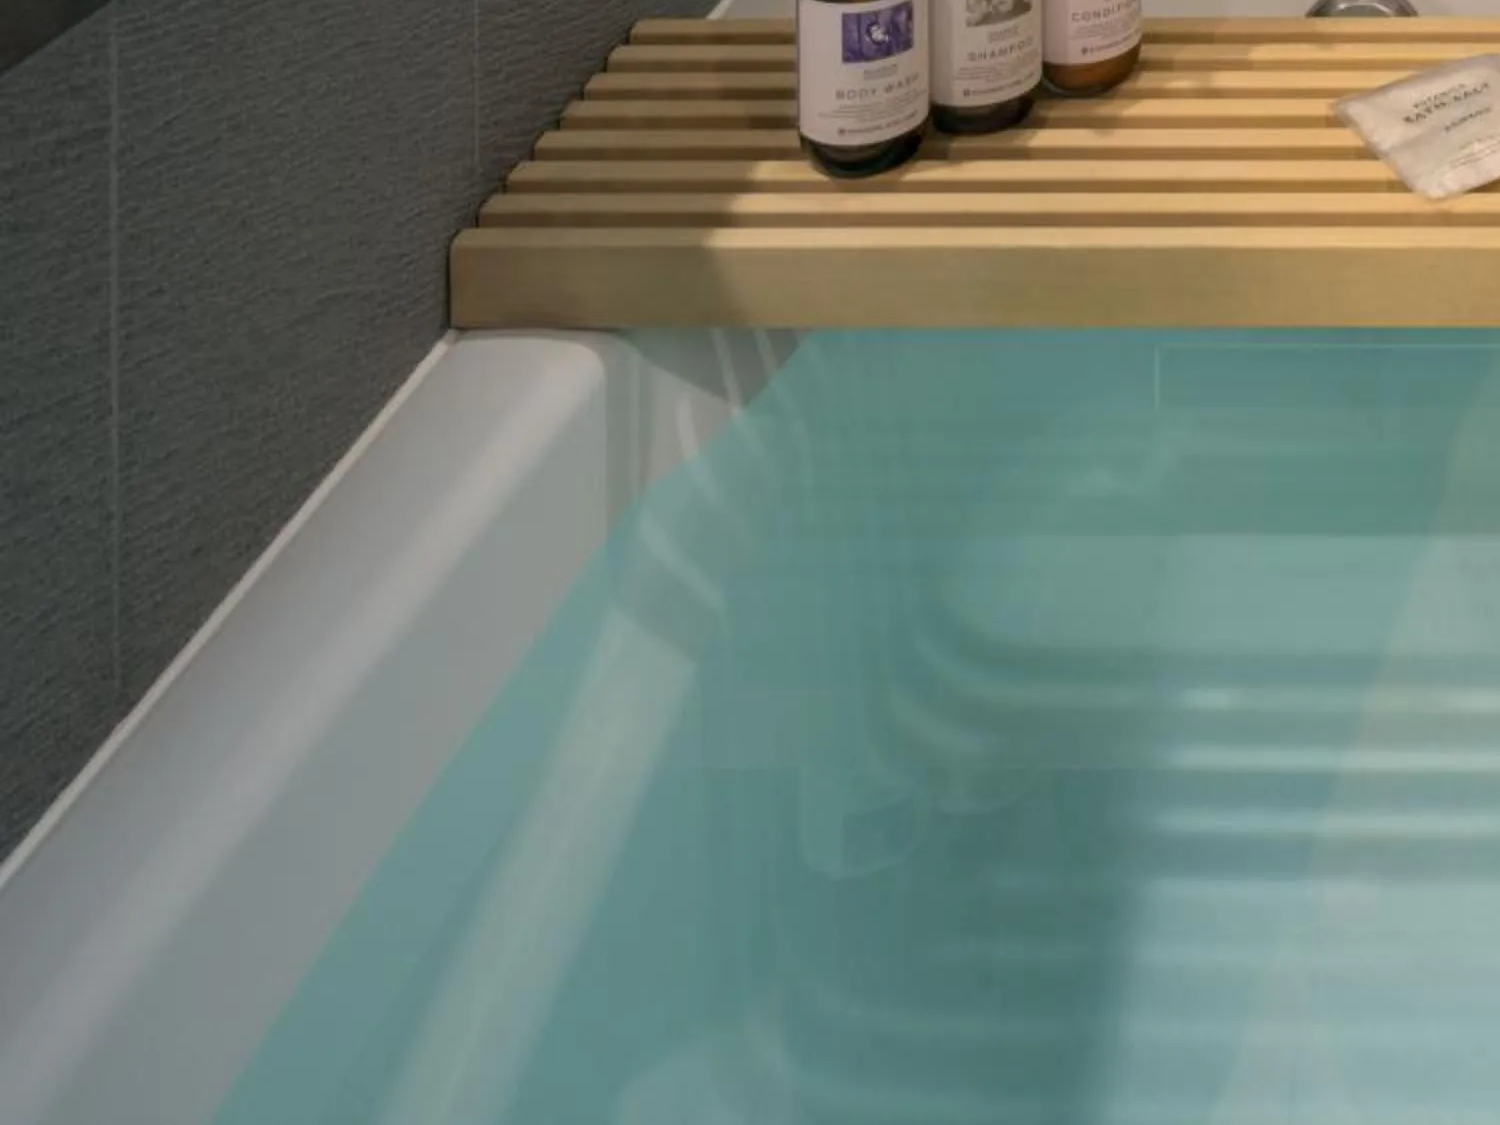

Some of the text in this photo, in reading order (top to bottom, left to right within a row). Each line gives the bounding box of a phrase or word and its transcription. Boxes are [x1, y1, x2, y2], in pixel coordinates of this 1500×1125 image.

[967, 35, 1034, 62] SHAMPOO
[835, 72, 920, 100] BODY WASH
